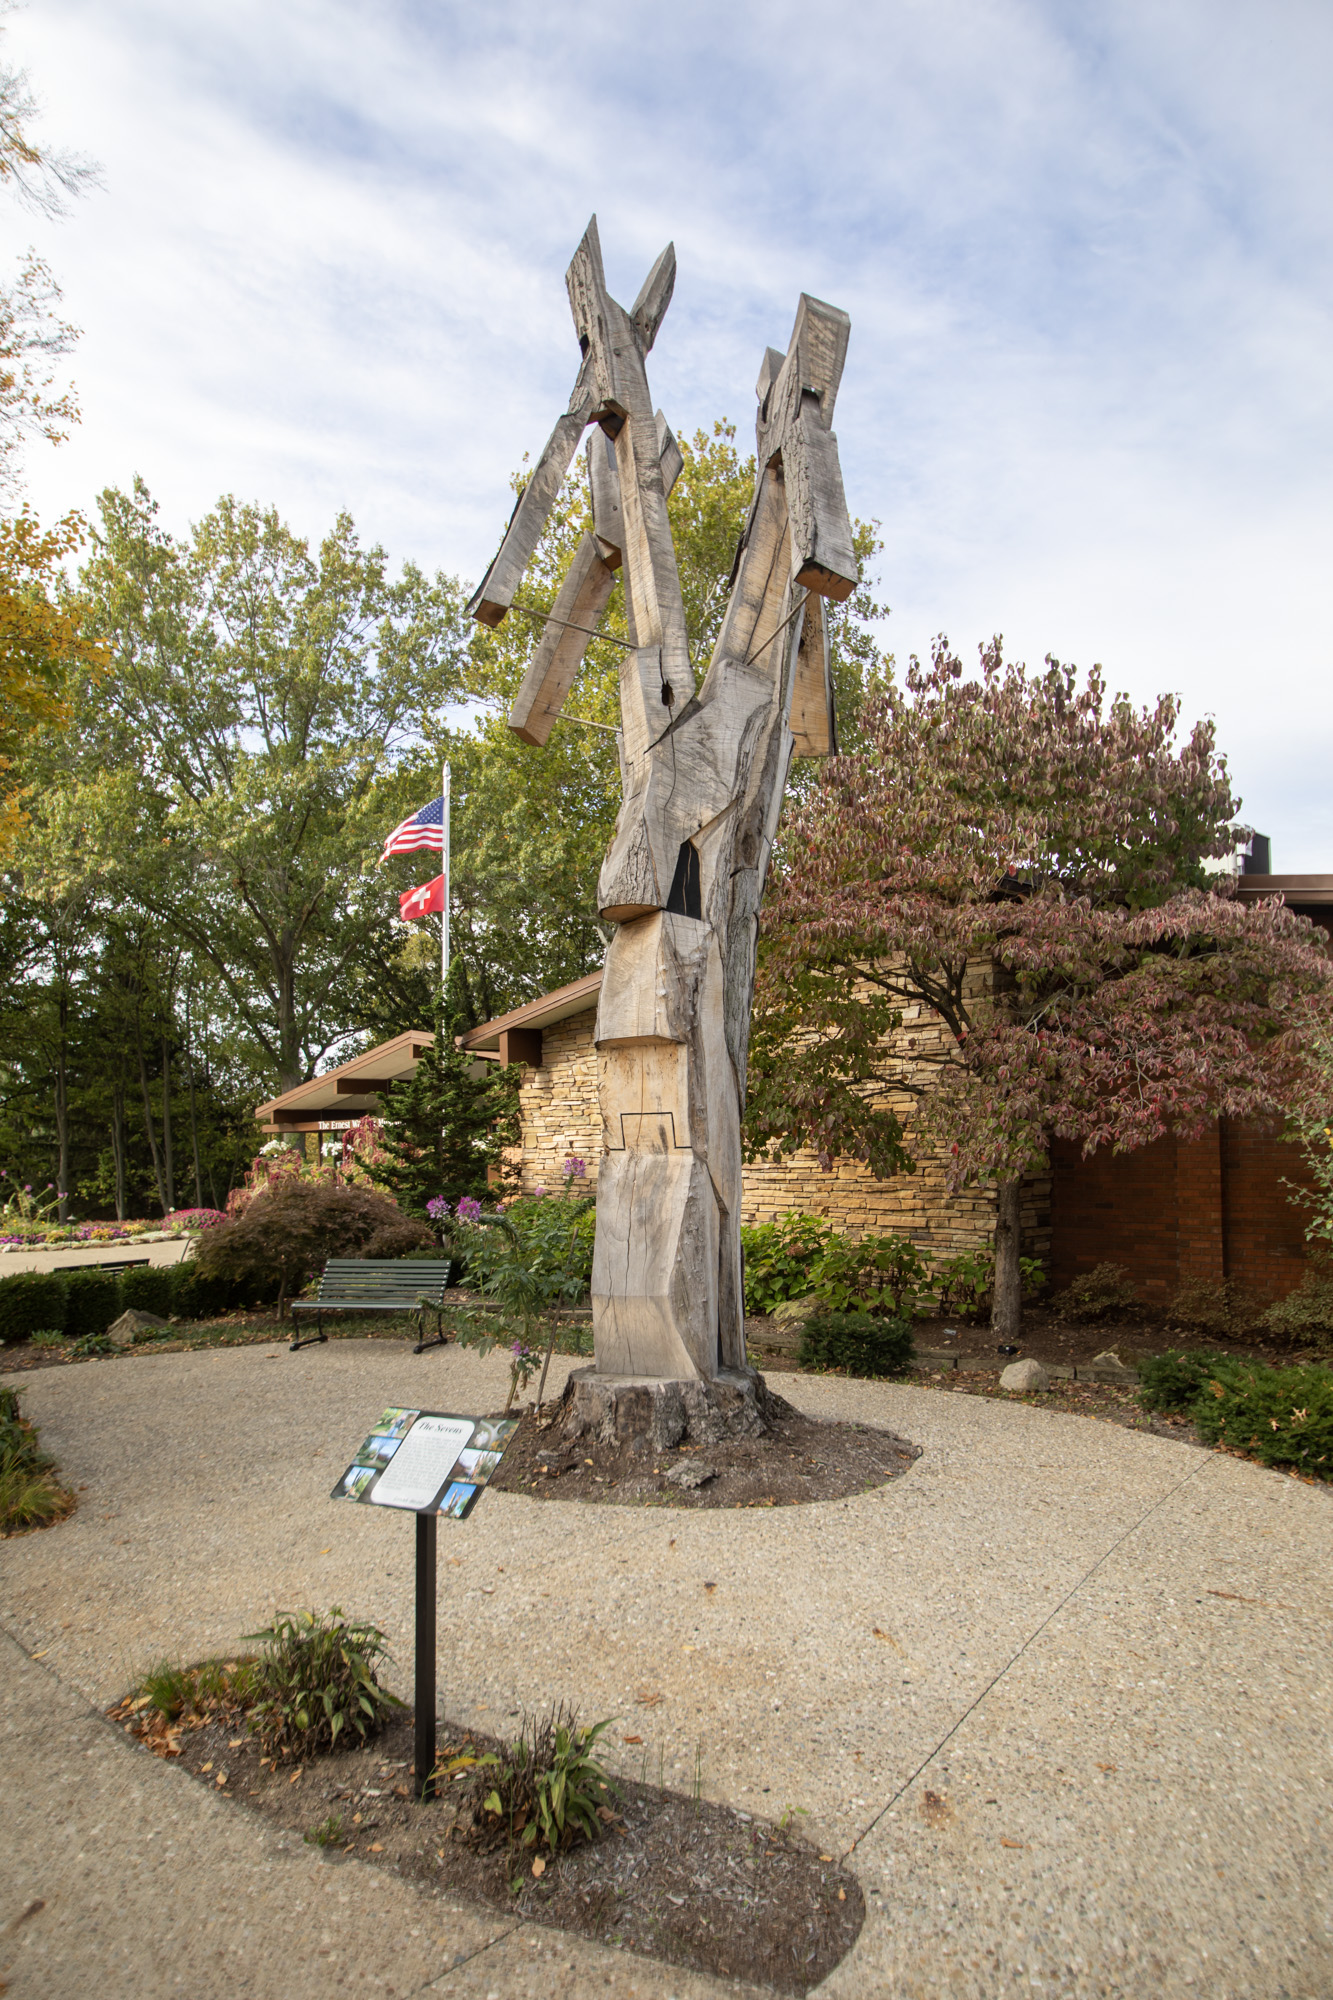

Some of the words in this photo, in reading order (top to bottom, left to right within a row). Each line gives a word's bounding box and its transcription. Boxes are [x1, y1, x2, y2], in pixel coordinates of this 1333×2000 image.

[318, 1121, 330, 1130] The
[331, 1120, 351, 1130] Ernest
[419, 1421, 434, 1431] The
[436, 1422, 464, 1434] Sevens
